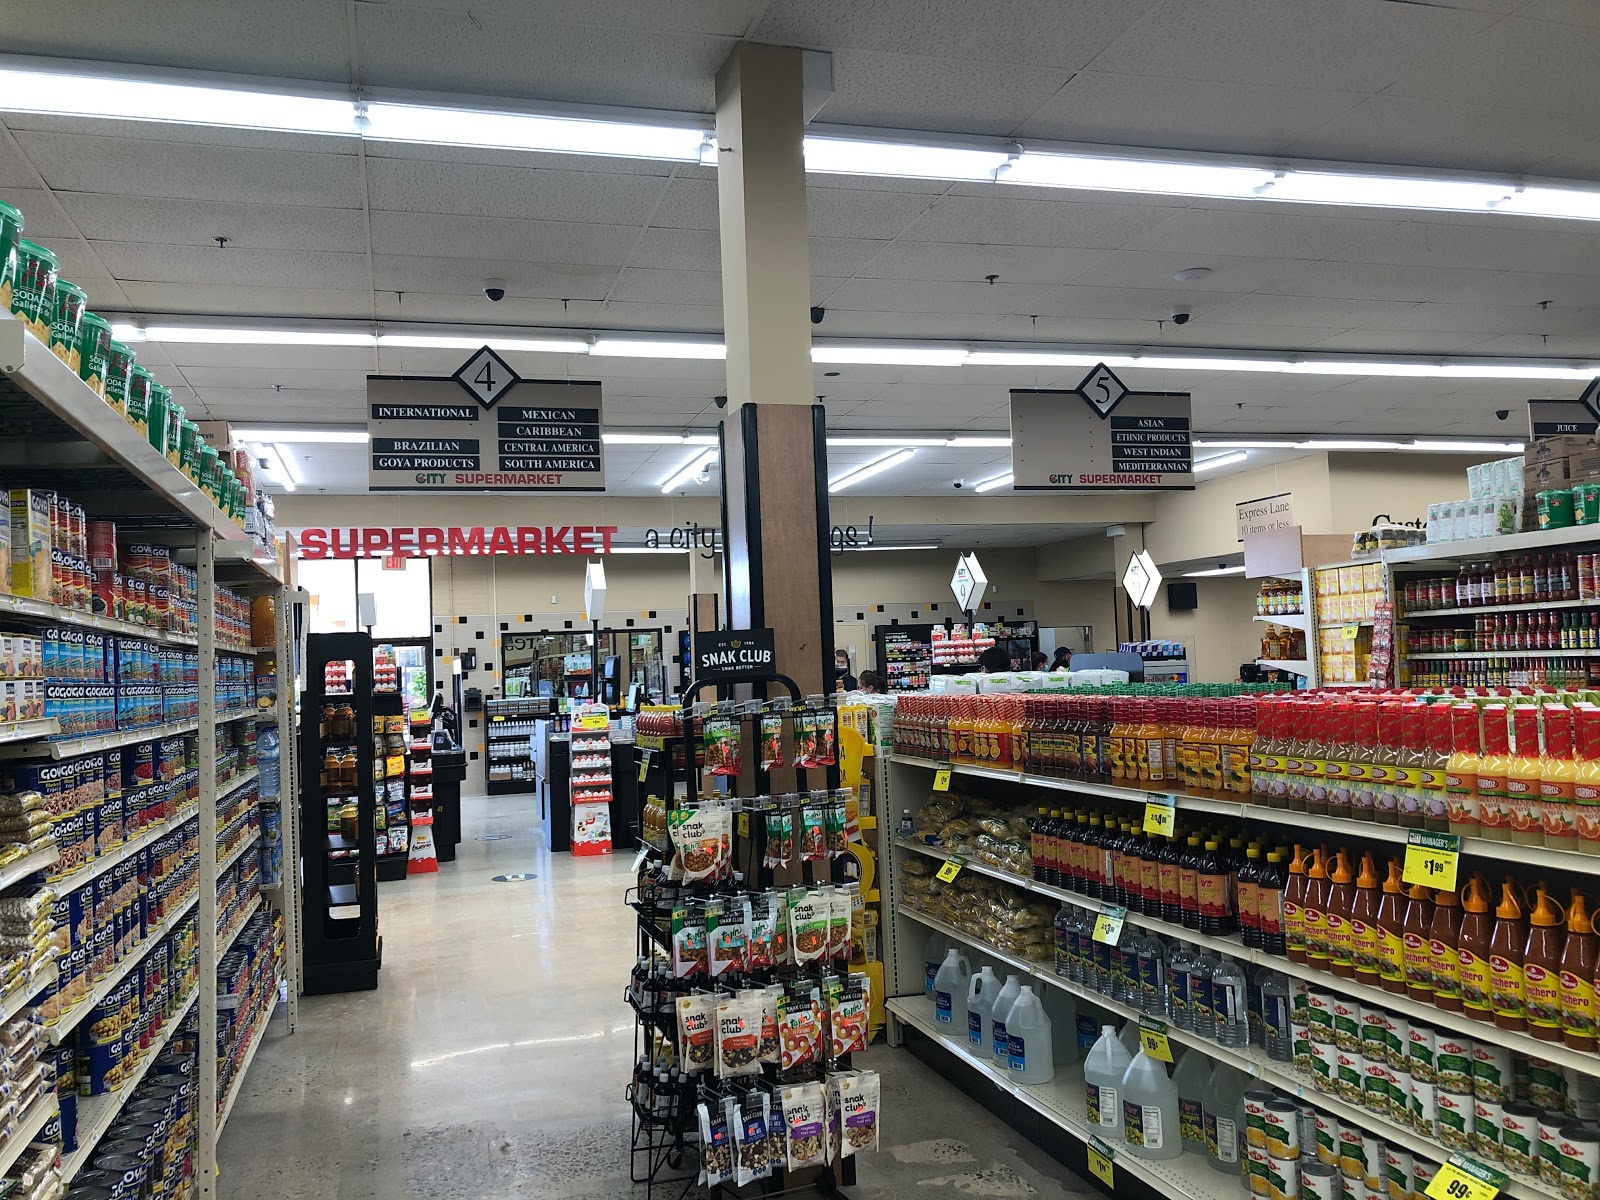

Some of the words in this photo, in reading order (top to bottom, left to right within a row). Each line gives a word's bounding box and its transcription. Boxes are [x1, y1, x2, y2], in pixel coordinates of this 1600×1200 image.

[52, 322, 75, 334] SODA
[474, 361, 496, 391] 4
[106, 378, 122, 387] ODA
[1095, 376, 1110, 404] 5
[378, 407, 473, 418] INTERNATIONAL
[522, 410, 576, 420] MEXICAN
[1138, 419, 1164, 428] ASIAN
[1556, 424, 1578, 432] JUICE
[516, 426, 582, 437] CARIBBEAN
[1116, 433, 1145, 442] ETHNIC
[1147, 434, 1186, 442] PRODUCTS
[393, 440, 460, 451] BRAZILIAN
[504, 442, 549, 452] CENTRAL
[551, 443, 594, 453] AMERICA
[1124, 448, 1148, 456] WEST
[379, 458, 411, 468] GOYA
[414, 458, 474, 468] PRODUCTS
[504, 459, 542, 469] SOUTH
[544, 459, 595, 469] AMERICA
[1118, 462, 1188, 471] MEDITERRANIAN
[415, 473, 447, 484] CITY
[455, 474, 562, 485] SUPERMARKET
[1049, 474, 1073, 484] CITY
[1079, 474, 1162, 484] SUPERMARKET
[31, 495, 48, 514] GOYA
[1239, 504, 1268, 521] Express
[1270, 501, 1290, 514] Lane
[1240, 525, 1249, 535] 10
[1249, 523, 1267, 533] items
[1268, 522, 1275, 531] or
[1276, 519, 1290, 530] less
[300, 526, 619, 559] SUPERMARKET
[644, 528, 659, 549] a
[670, 521, 716, 559] city
[386, 557, 403, 569] EXIT
[960, 584, 966, 603] 9
[701, 650, 736, 668] SNAK
[740, 649, 772, 663] CLUB
[682, 822, 704, 830] snak
[682, 830, 703, 839] club
[1421, 836, 1449, 849] MANAGER'S
[794, 904, 813, 913] snak
[795, 912, 813, 921] club
[685, 1013, 706, 1023] snak
[721, 1025, 742, 1034] club
[844, 1094, 864, 1104] snak
[787, 1104, 809, 1114] snak
[845, 1102, 864, 1112] club
